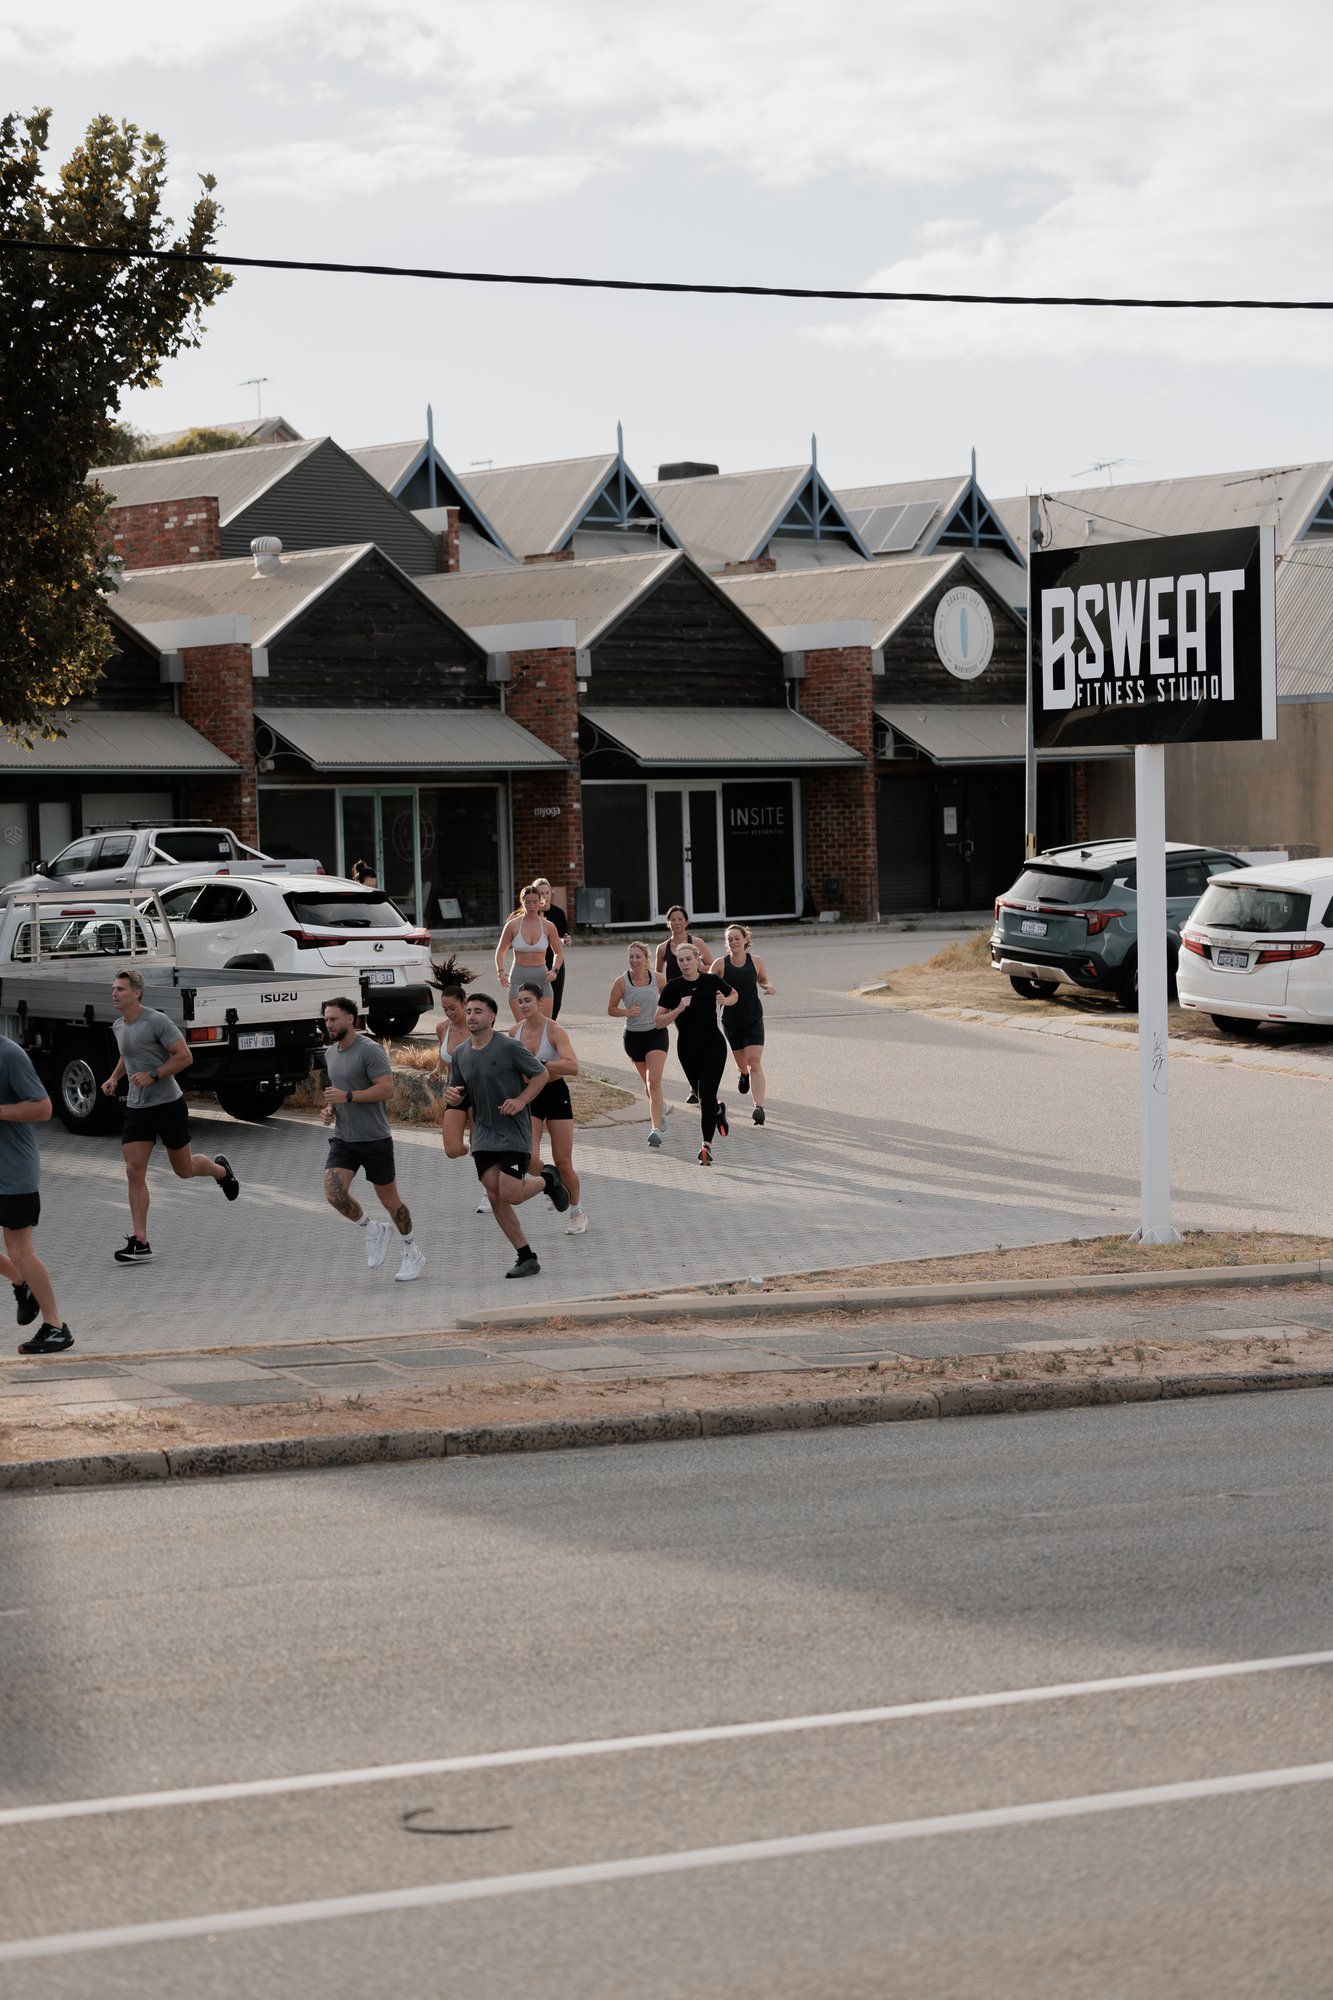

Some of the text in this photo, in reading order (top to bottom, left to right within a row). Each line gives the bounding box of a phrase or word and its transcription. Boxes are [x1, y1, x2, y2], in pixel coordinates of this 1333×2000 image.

[1041, 569, 1245, 710] BSWEAT
[1077, 675, 1219, 706] FITNESS STUDIO
[534, 806, 561, 818] myoga
[730, 806, 784, 826] INSITE
[260, 992, 298, 1003] ISUZU
